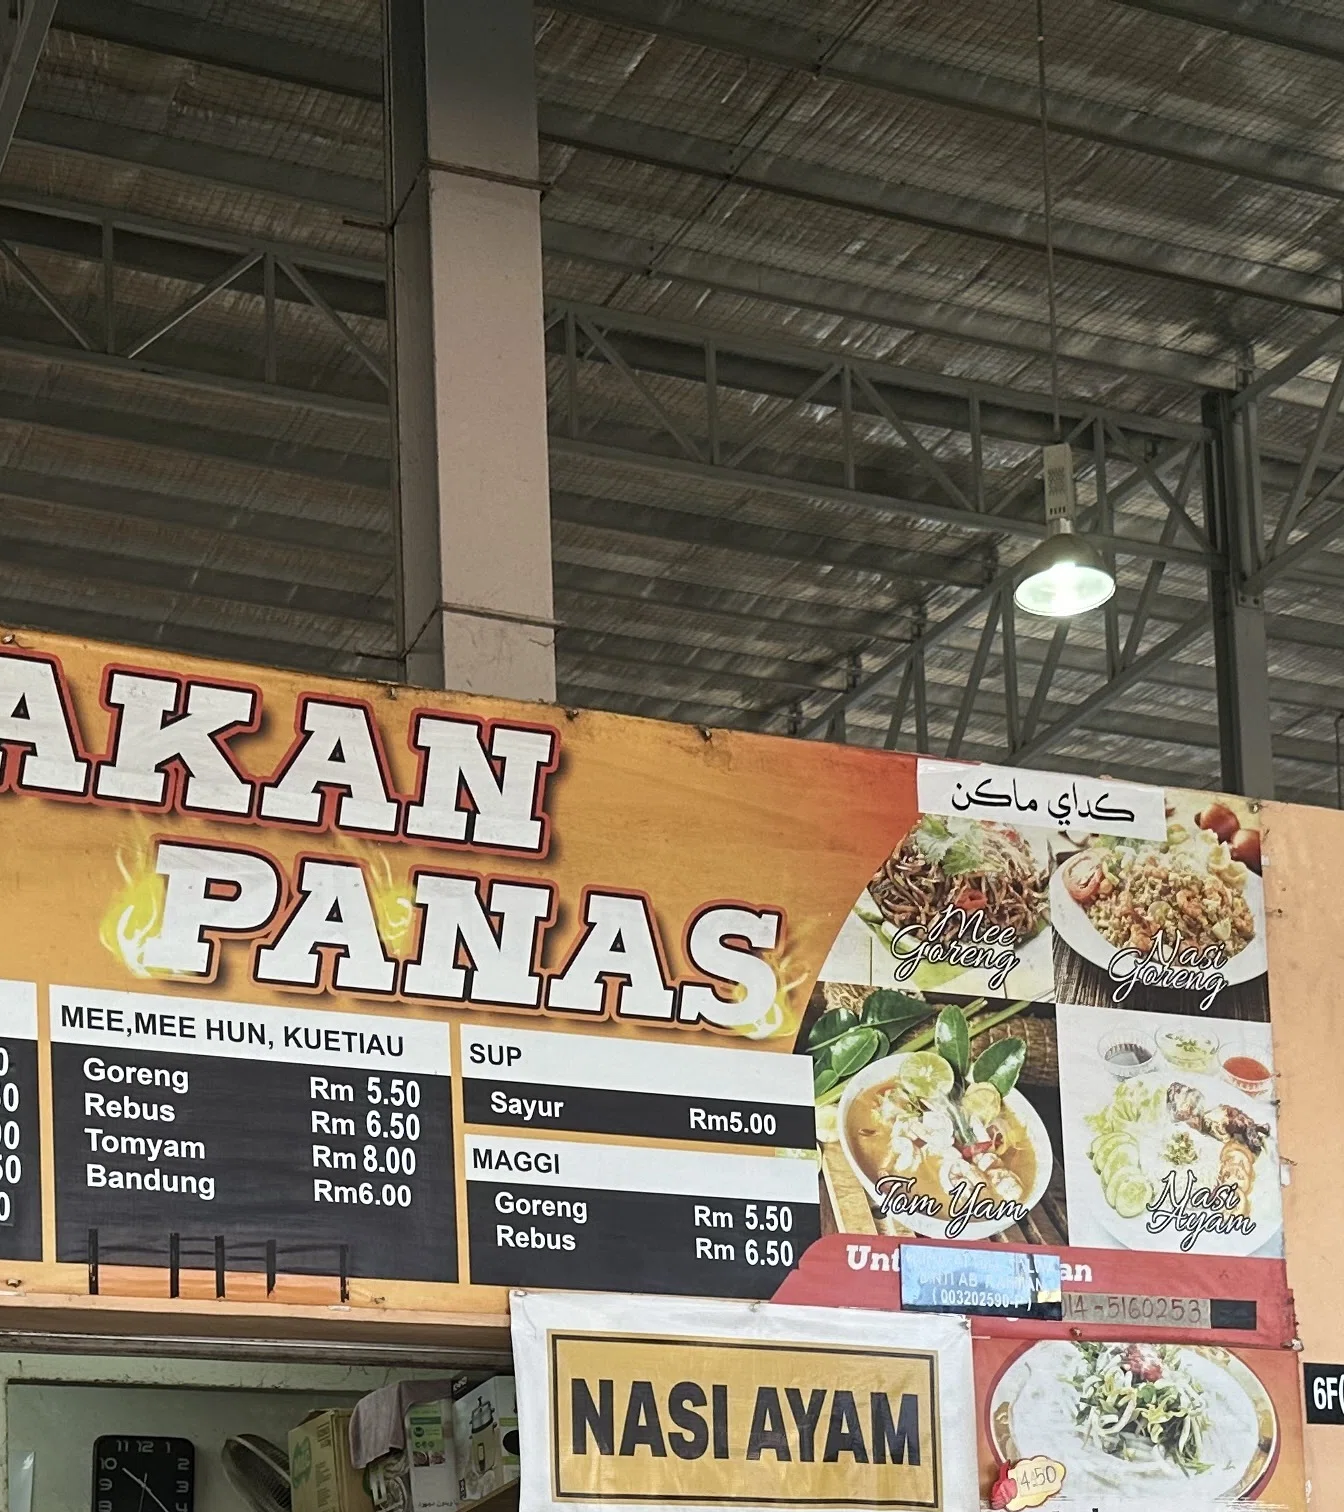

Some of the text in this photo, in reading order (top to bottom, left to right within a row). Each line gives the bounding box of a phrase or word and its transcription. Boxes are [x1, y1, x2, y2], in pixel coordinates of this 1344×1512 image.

[137, 843, 786, 1029] PANAS
[928, 903, 1016, 946] Mee
[890, 923, 1019, 989] Goreng
[1145, 929, 1227, 970] Nasi
[1108, 946, 1228, 1010] Goreng
[61, 1005, 404, 1057] MEE,MEE HUN, KUETIAU
[469, 1043, 522, 1067] SUP
[83, 1057, 420, 1108] Goreng Rm 5.50
[84, 1093, 420, 1141] Rebus Rm 6.50
[490, 1091, 776, 1135] Sayur Rm5.00
[84, 1127, 205, 1161] Tomyam
[473, 1148, 560, 1174] MAGGI
[86, 1163, 215, 1201] Bandung
[1152, 1170, 1239, 1211] Nasi
[494, 1191, 792, 1233] Goreng Rm 5.50
[875, 1176, 1030, 1240] Tom Yam
[1146, 1202, 1256, 1253] Ayam
[496, 1224, 793, 1267] Rebus Rm 6.50
[571, 1377, 921, 1466] NASI AYAM
